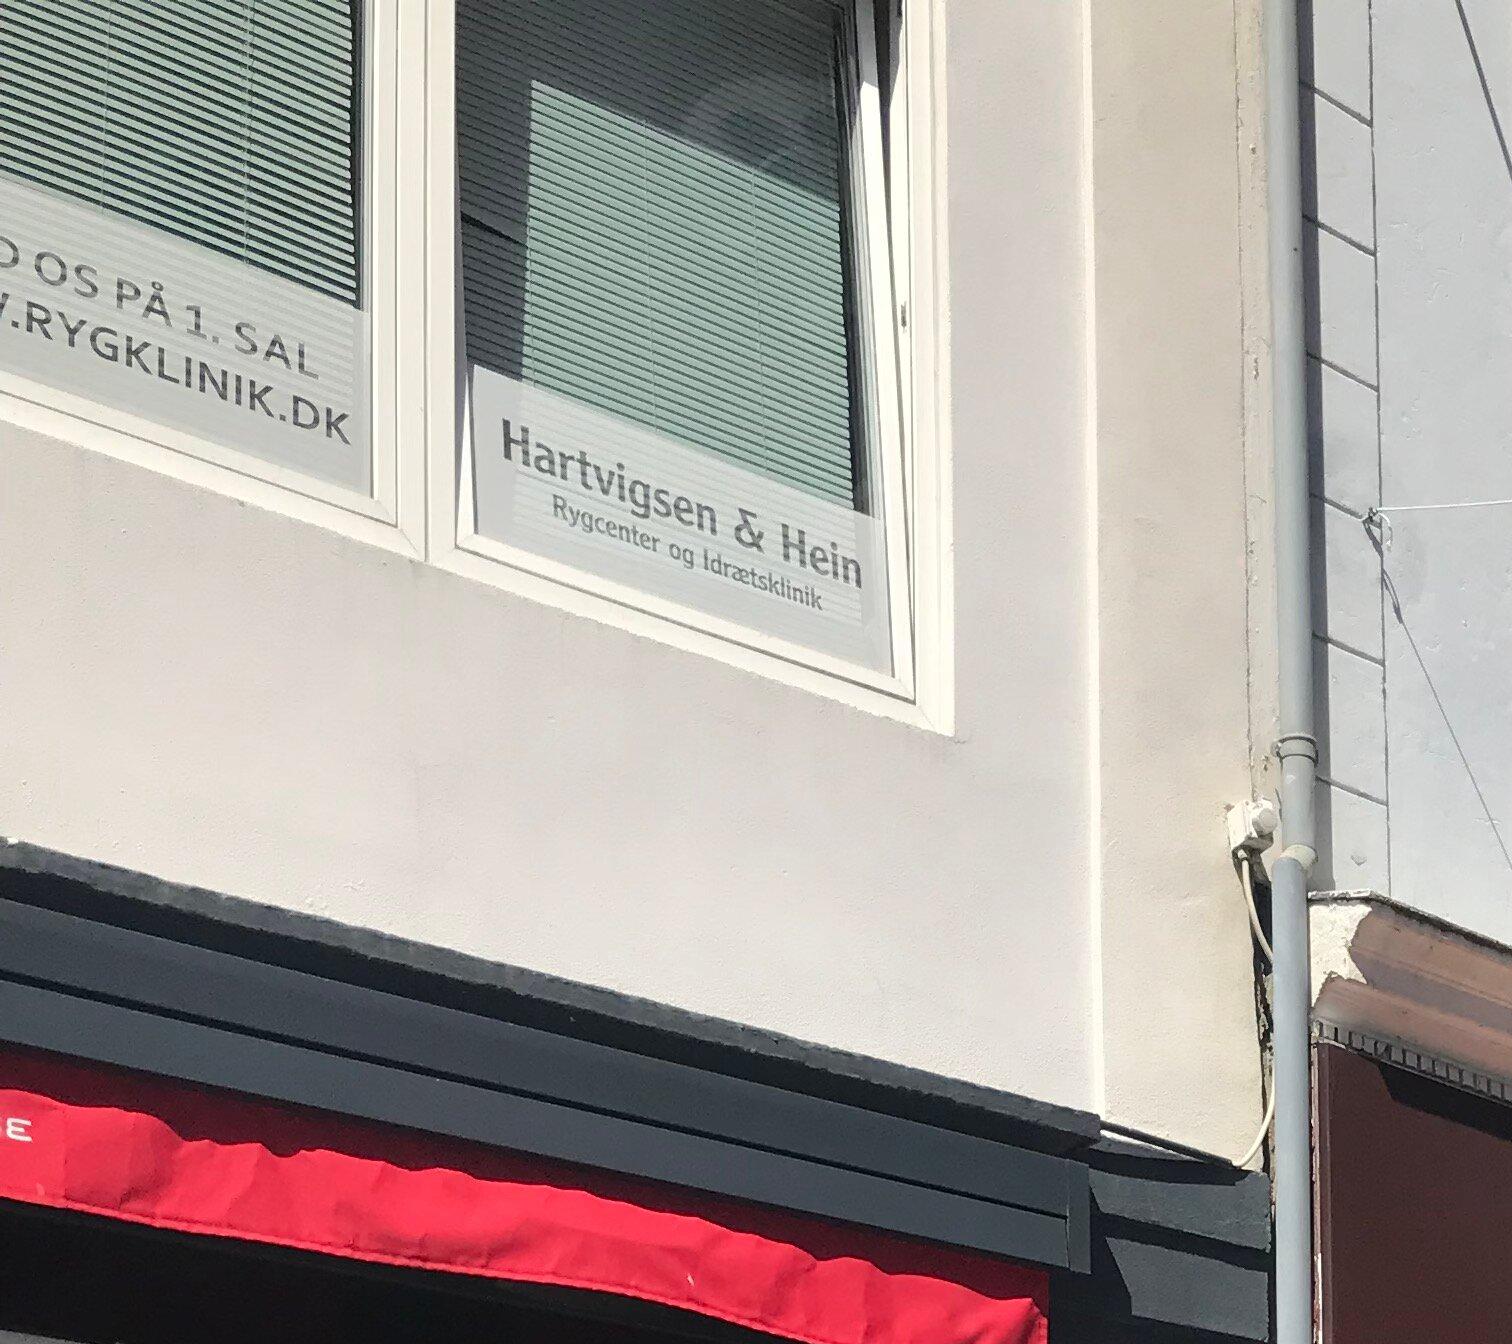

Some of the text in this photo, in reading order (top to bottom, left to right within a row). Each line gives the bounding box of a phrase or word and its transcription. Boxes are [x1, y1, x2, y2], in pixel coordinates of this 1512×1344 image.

[0, 292, 350, 446] .RYGKLINIK.DK
[34, 251, 99, 298] OS
[116, 277, 172, 328] PÅ
[186, 304, 220, 344] 1.
[235, 321, 319, 380] SAL
[502, 417, 862, 589] Hartvigsen & Hein
[552, 493, 823, 611] Rygcenter og Idrætsklinik
